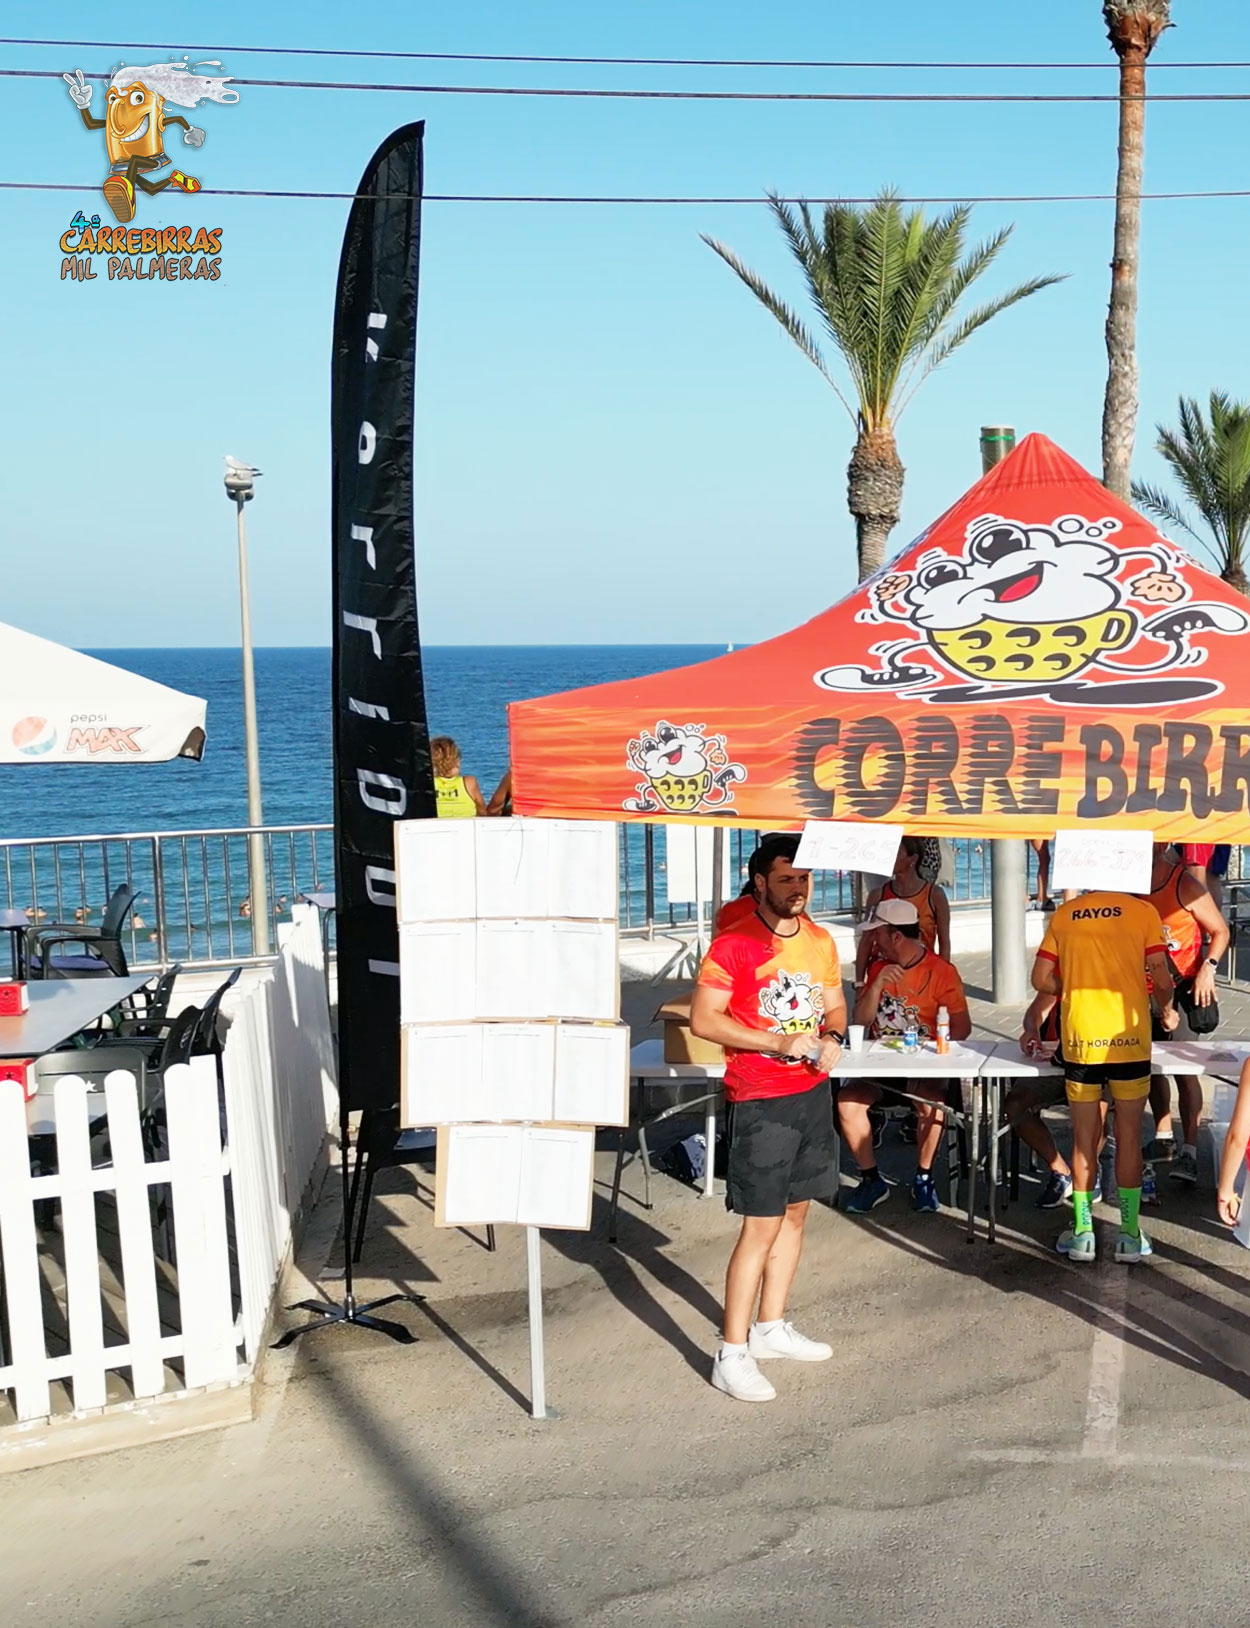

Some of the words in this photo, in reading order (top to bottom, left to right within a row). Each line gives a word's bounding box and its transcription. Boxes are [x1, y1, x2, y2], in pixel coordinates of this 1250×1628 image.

[70, 713, 108, 724] pepsi
[65, 726, 146, 755] MAX
[788, 714, 1066, 818] CORRE
[1072, 907, 1122, 920] RAYOS
